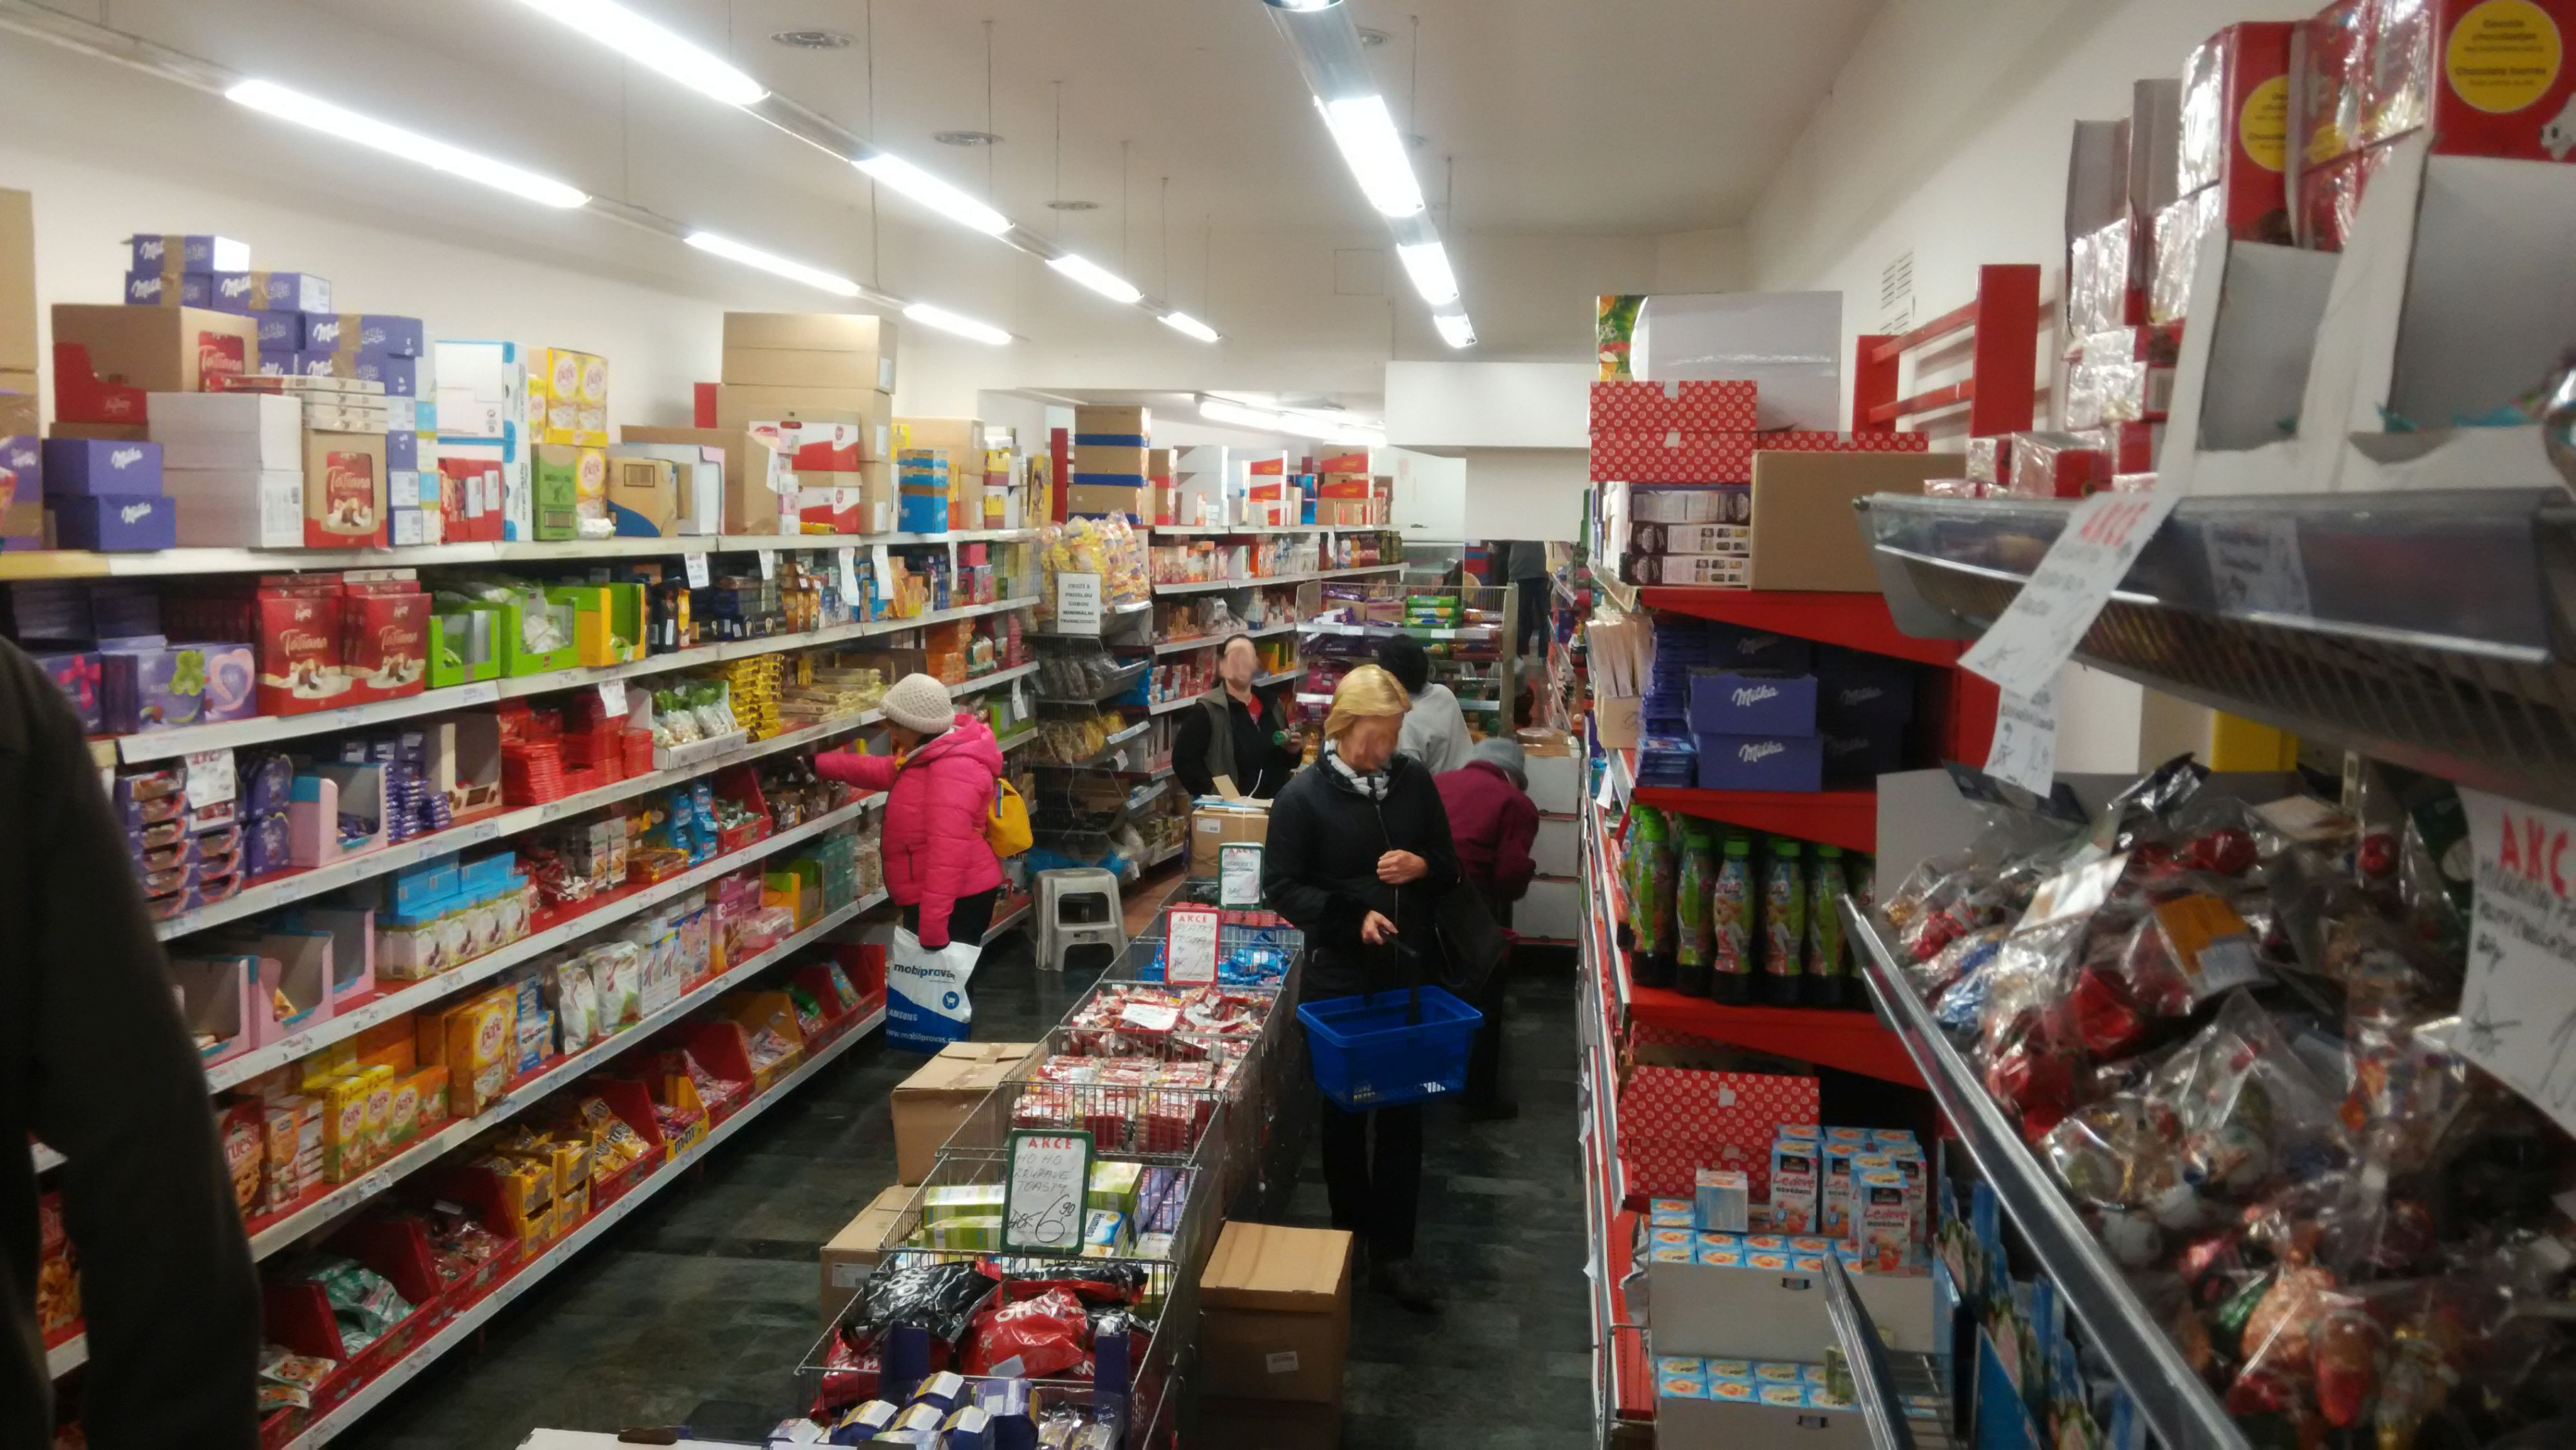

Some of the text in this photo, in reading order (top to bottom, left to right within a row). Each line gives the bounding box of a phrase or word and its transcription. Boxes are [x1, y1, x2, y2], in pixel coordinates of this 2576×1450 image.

[279, 628, 328, 658] Tatiana
[379, 625, 418, 652] Tatiana
[1732, 685, 1779, 706] Milka
[1738, 740, 1785, 763] Milka
[1179, 915, 1208, 923] AKCE
[1027, 1137, 1073, 1150] AKCE
[1015, 1153, 1063, 1165] HO HO
[1017, 1180, 1068, 1194] TOASTY
[1084, 1212, 1106, 1237] Humana
